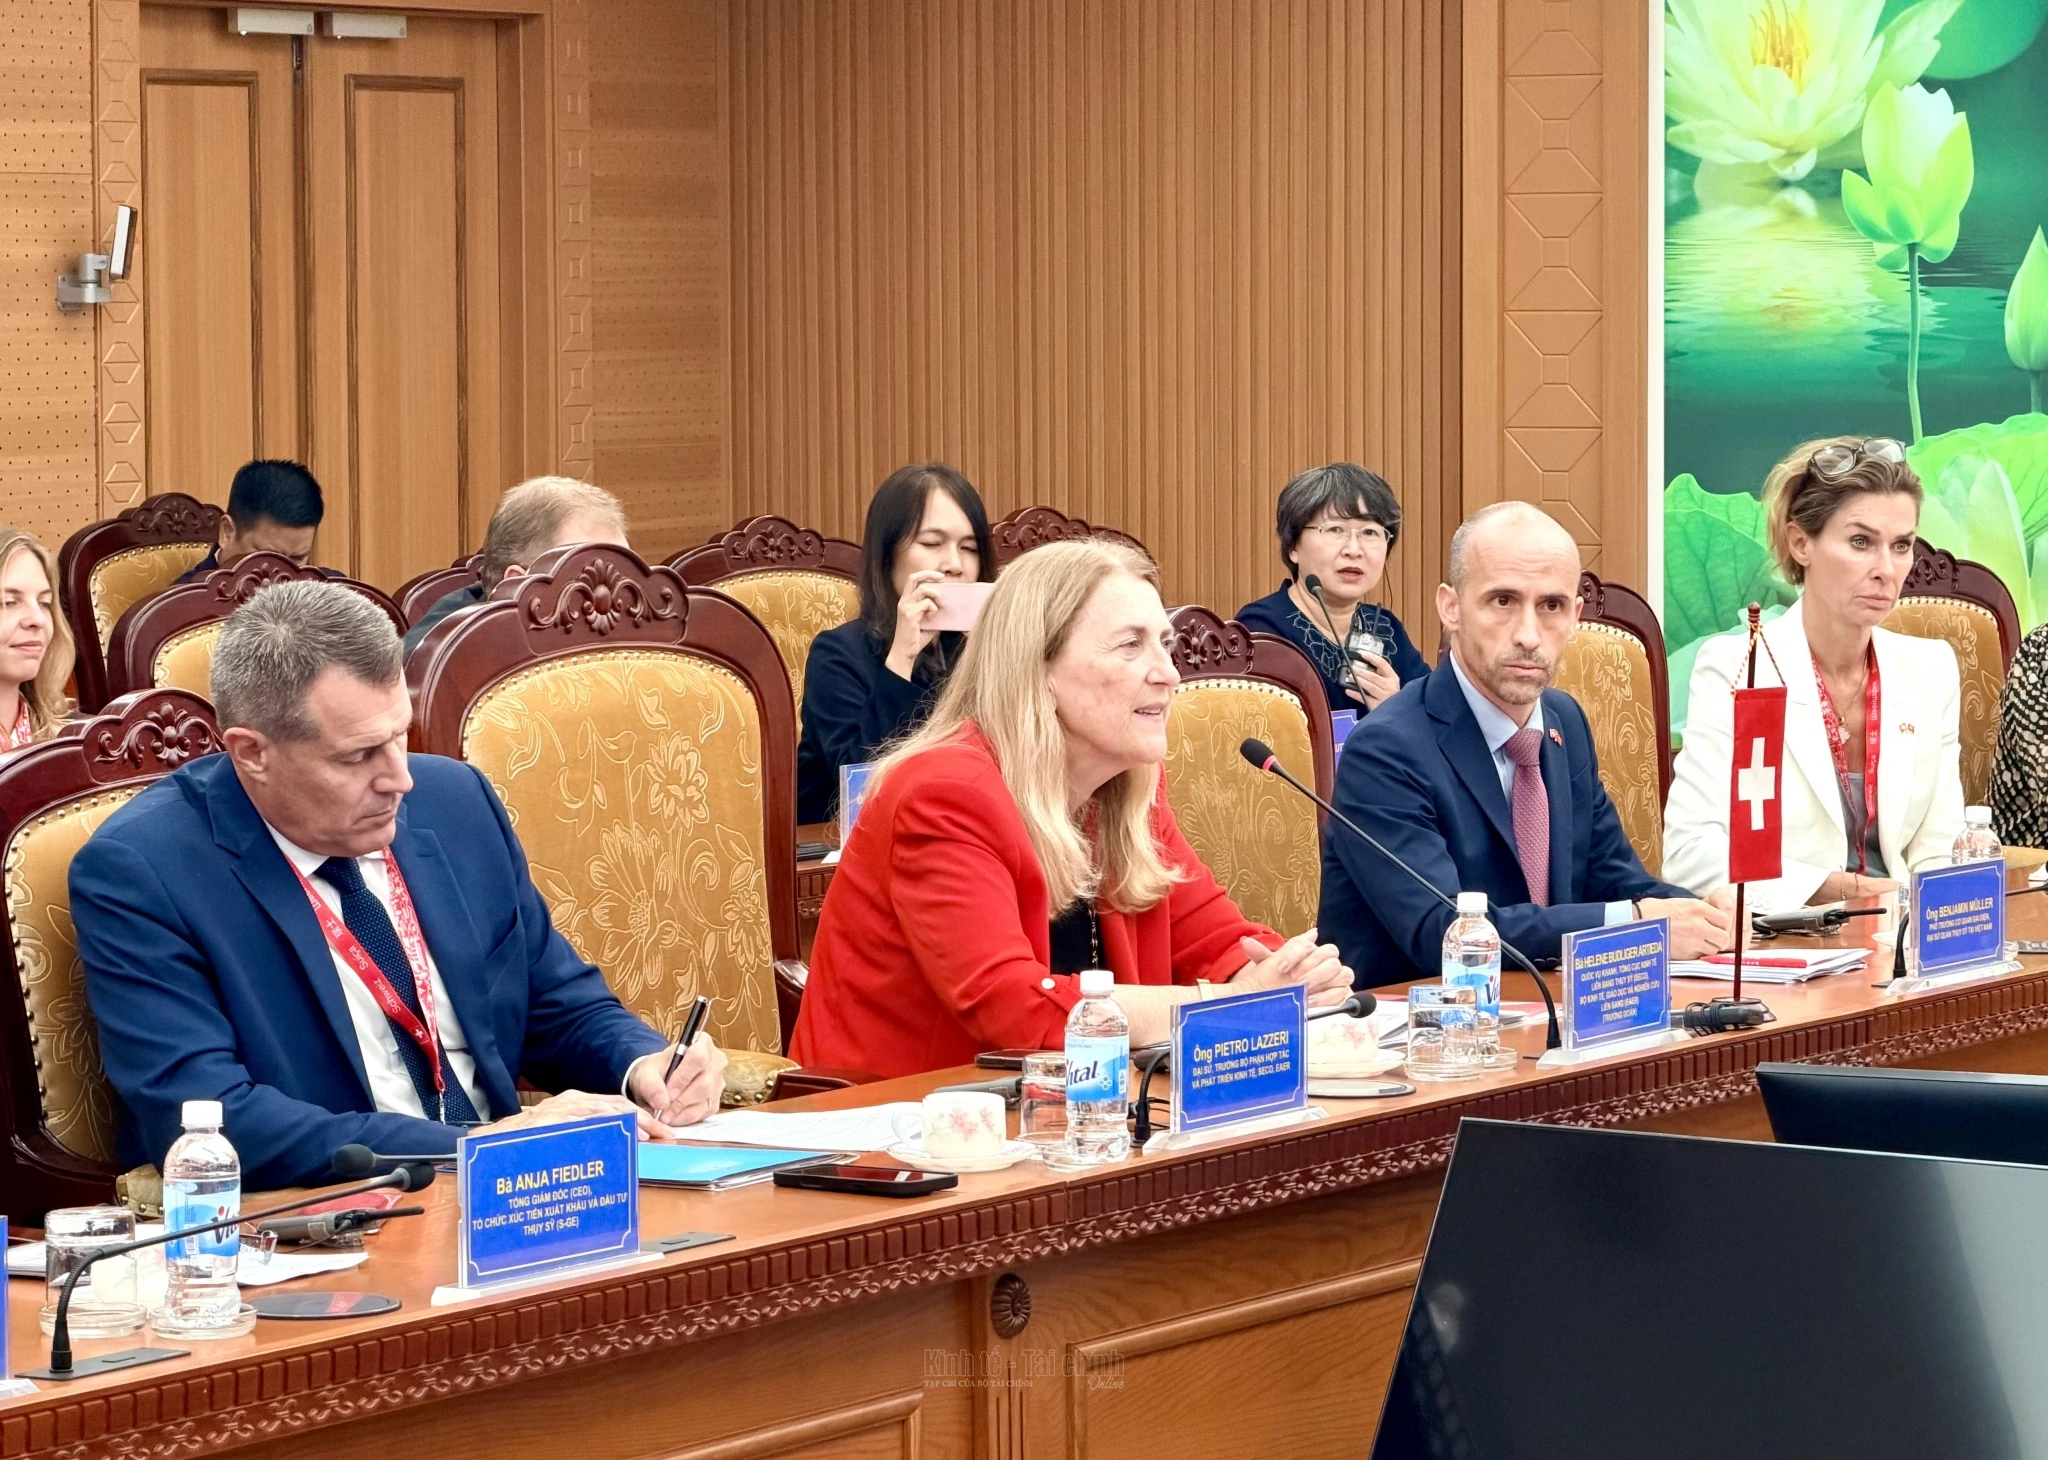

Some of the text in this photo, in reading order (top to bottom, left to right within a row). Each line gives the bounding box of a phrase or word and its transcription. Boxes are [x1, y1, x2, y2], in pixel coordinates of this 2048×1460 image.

[1926, 897, 1993, 921] Ông BENJAMIN MÜLLER
[326, 918, 344, 939] 瑞士
[349, 945, 400, 1014] Schweiz Suíça
[1484, 975, 1499, 1004] Vit
[1194, 1030, 1289, 1064] Ông PIETRO LAZZERI
[1279, 1049, 1290, 1059] TÁC
[1234, 1069, 1247, 1081] KINH
[1258, 1065, 1274, 1077] SECO,
[1276, 1062, 1290, 1073] EAER
[497, 1160, 604, 1195] Bà ANJA FIEDLER
[532, 1192, 550, 1205] GIÁM
[570, 1185, 593, 1199] (CEO),
[588, 1196, 598, 1208] VÀ
[617, 1192, 628, 1204] TƯ
[524, 1224, 543, 1236] THỤY
[557, 1216, 580, 1231] (S-GE)
